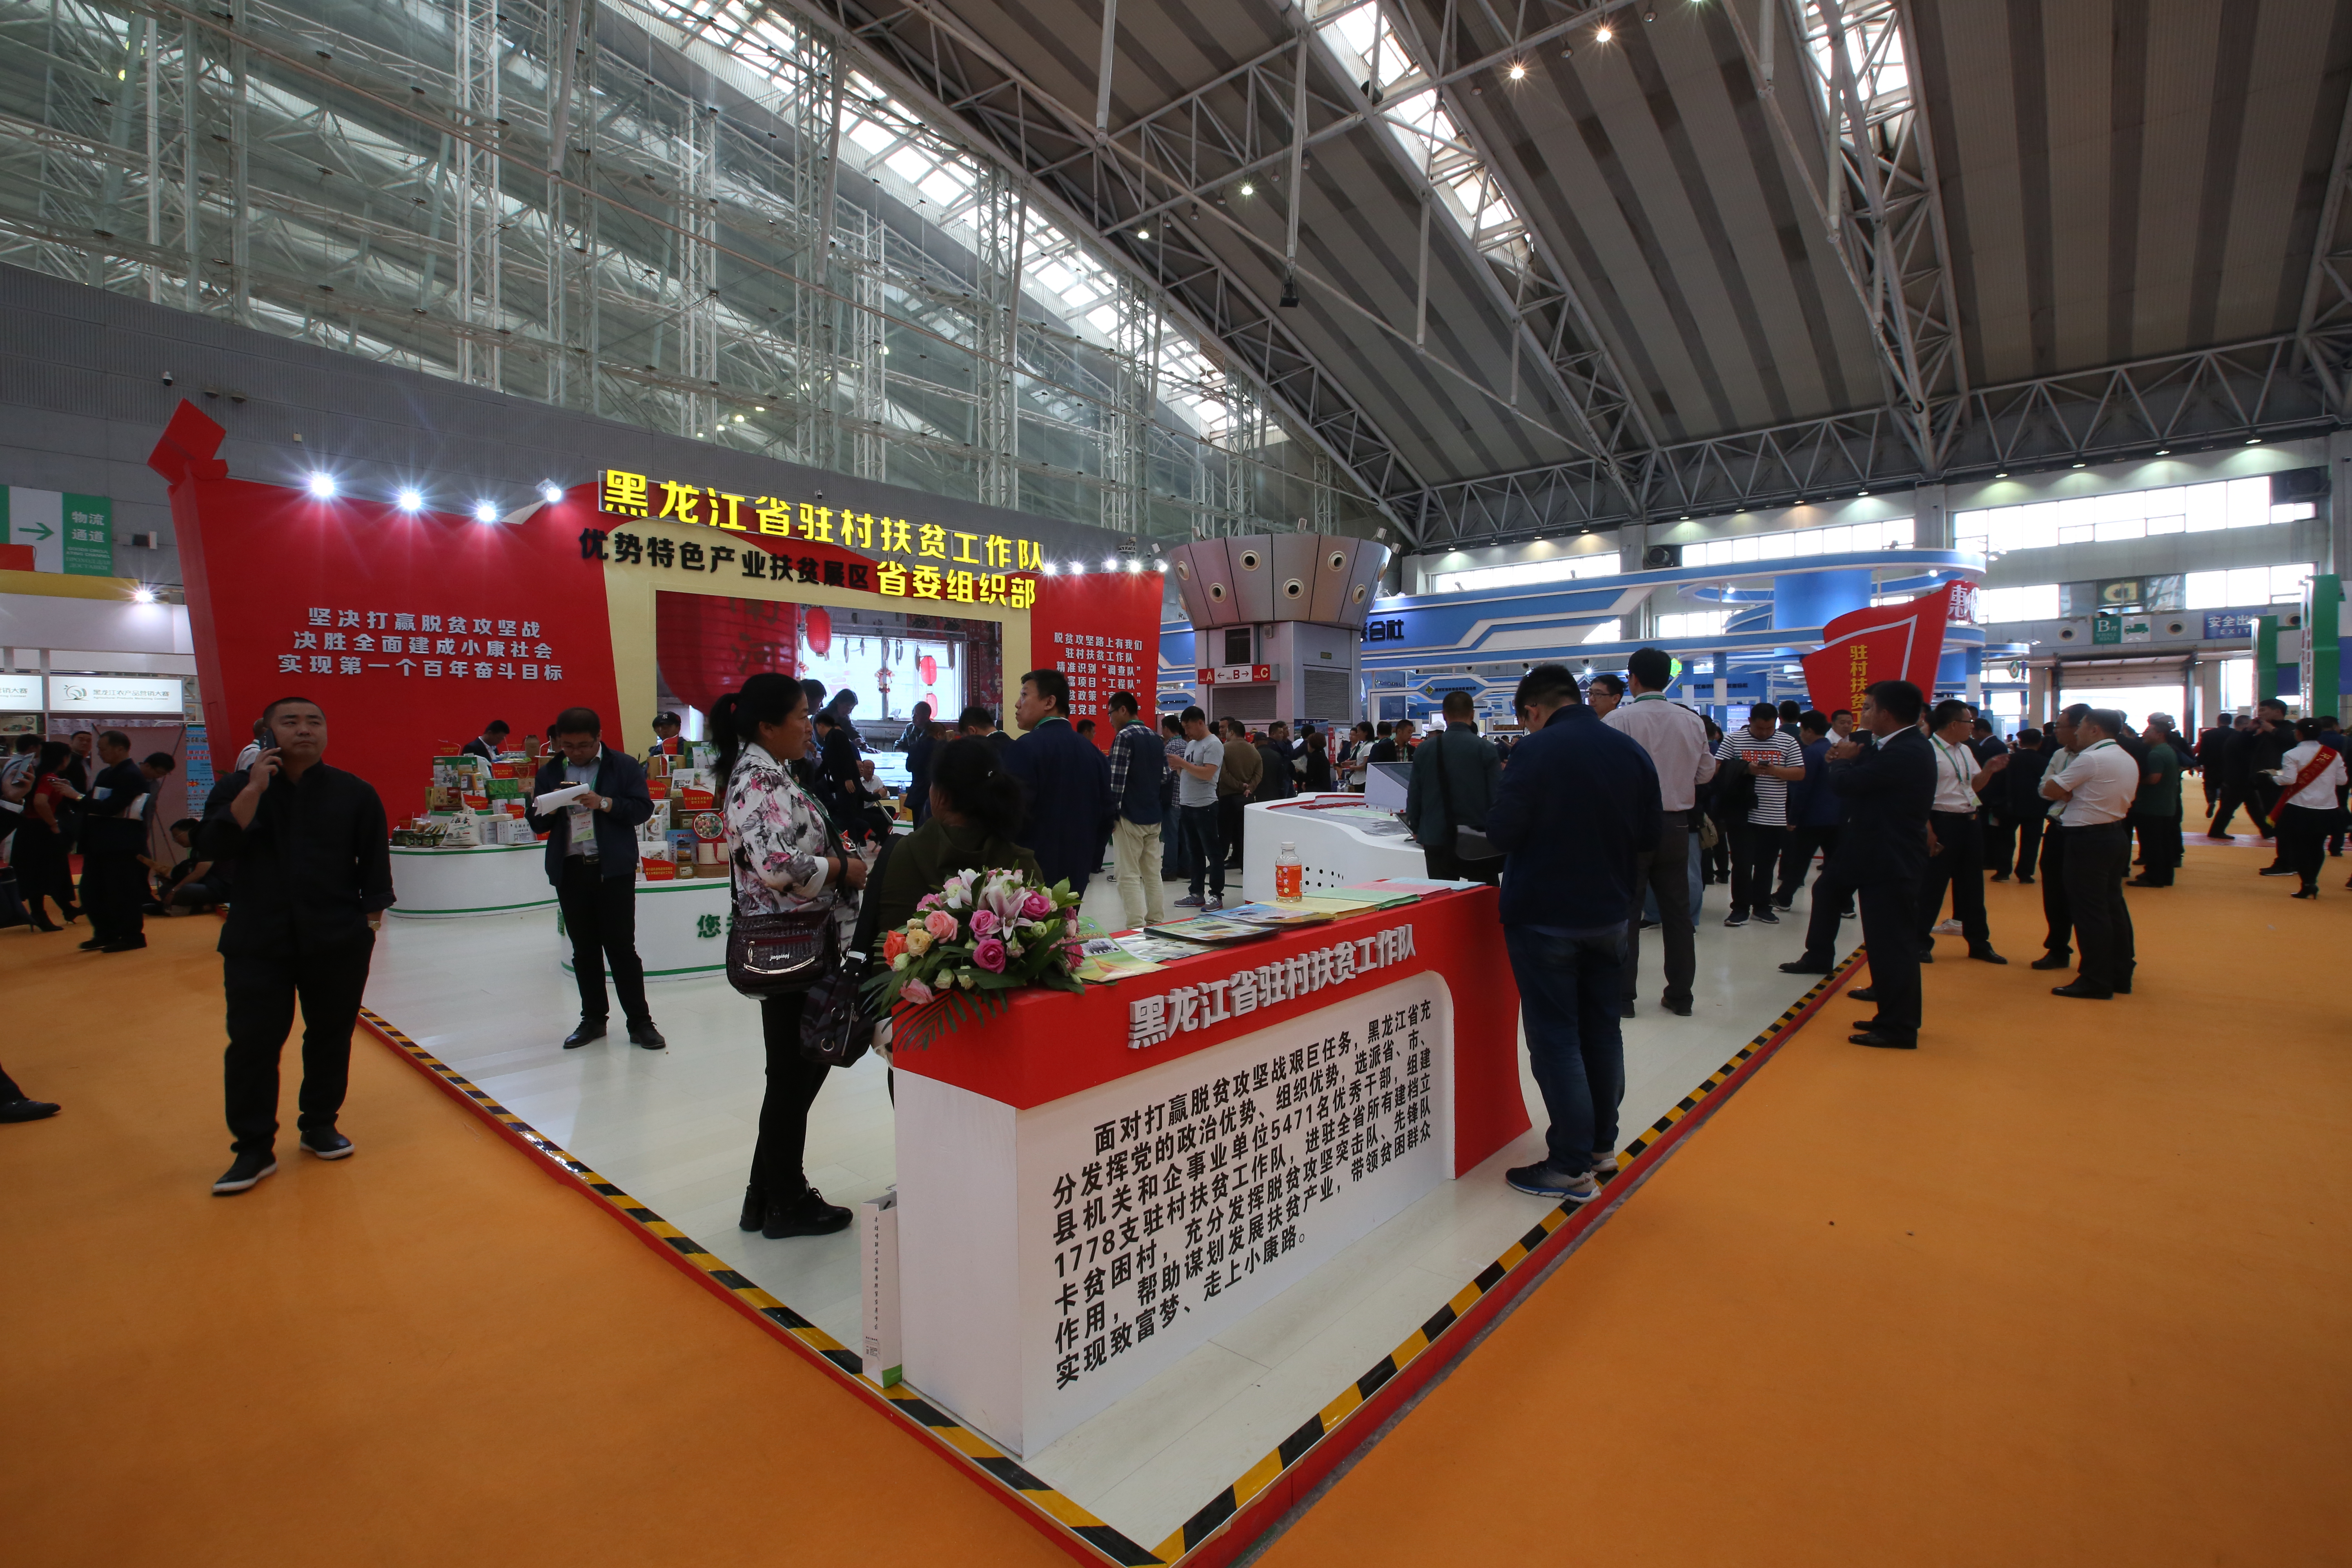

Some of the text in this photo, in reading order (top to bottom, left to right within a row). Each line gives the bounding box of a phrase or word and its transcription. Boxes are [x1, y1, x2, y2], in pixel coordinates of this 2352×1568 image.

[72, 511, 105, 526] 物流
[604, 469, 1045, 572] 黑龙江省驻村扶贫工作队
[72, 529, 105, 543] 通道
[579, 528, 869, 589] 优势特色产业扶贫展区
[877, 561, 1036, 609] 省委组织部
[308, 607, 540, 638] 坚决打赢脱贫攻坚战
[2208, 614, 2256, 628] 安全出
[293, 631, 552, 659] 决胜全面建成小康社会
[1054, 632, 1143, 651] 脱贫攻坚路上有我们
[278, 654, 563, 681] 实现第一个百年奋斗目标
[1065, 648, 1133, 663] 驻村扶贫工作队
[1206, 671, 1213, 682] A
[1234, 670, 1240, 679] B
[1260, 667, 1268, 678] C
[1850, 644, 1868, 732] 驻村扶贫工
[697, 913, 733, 938] 您
[1127, 924, 1416, 1049] 黑龙江省驻村扶贫工作队
